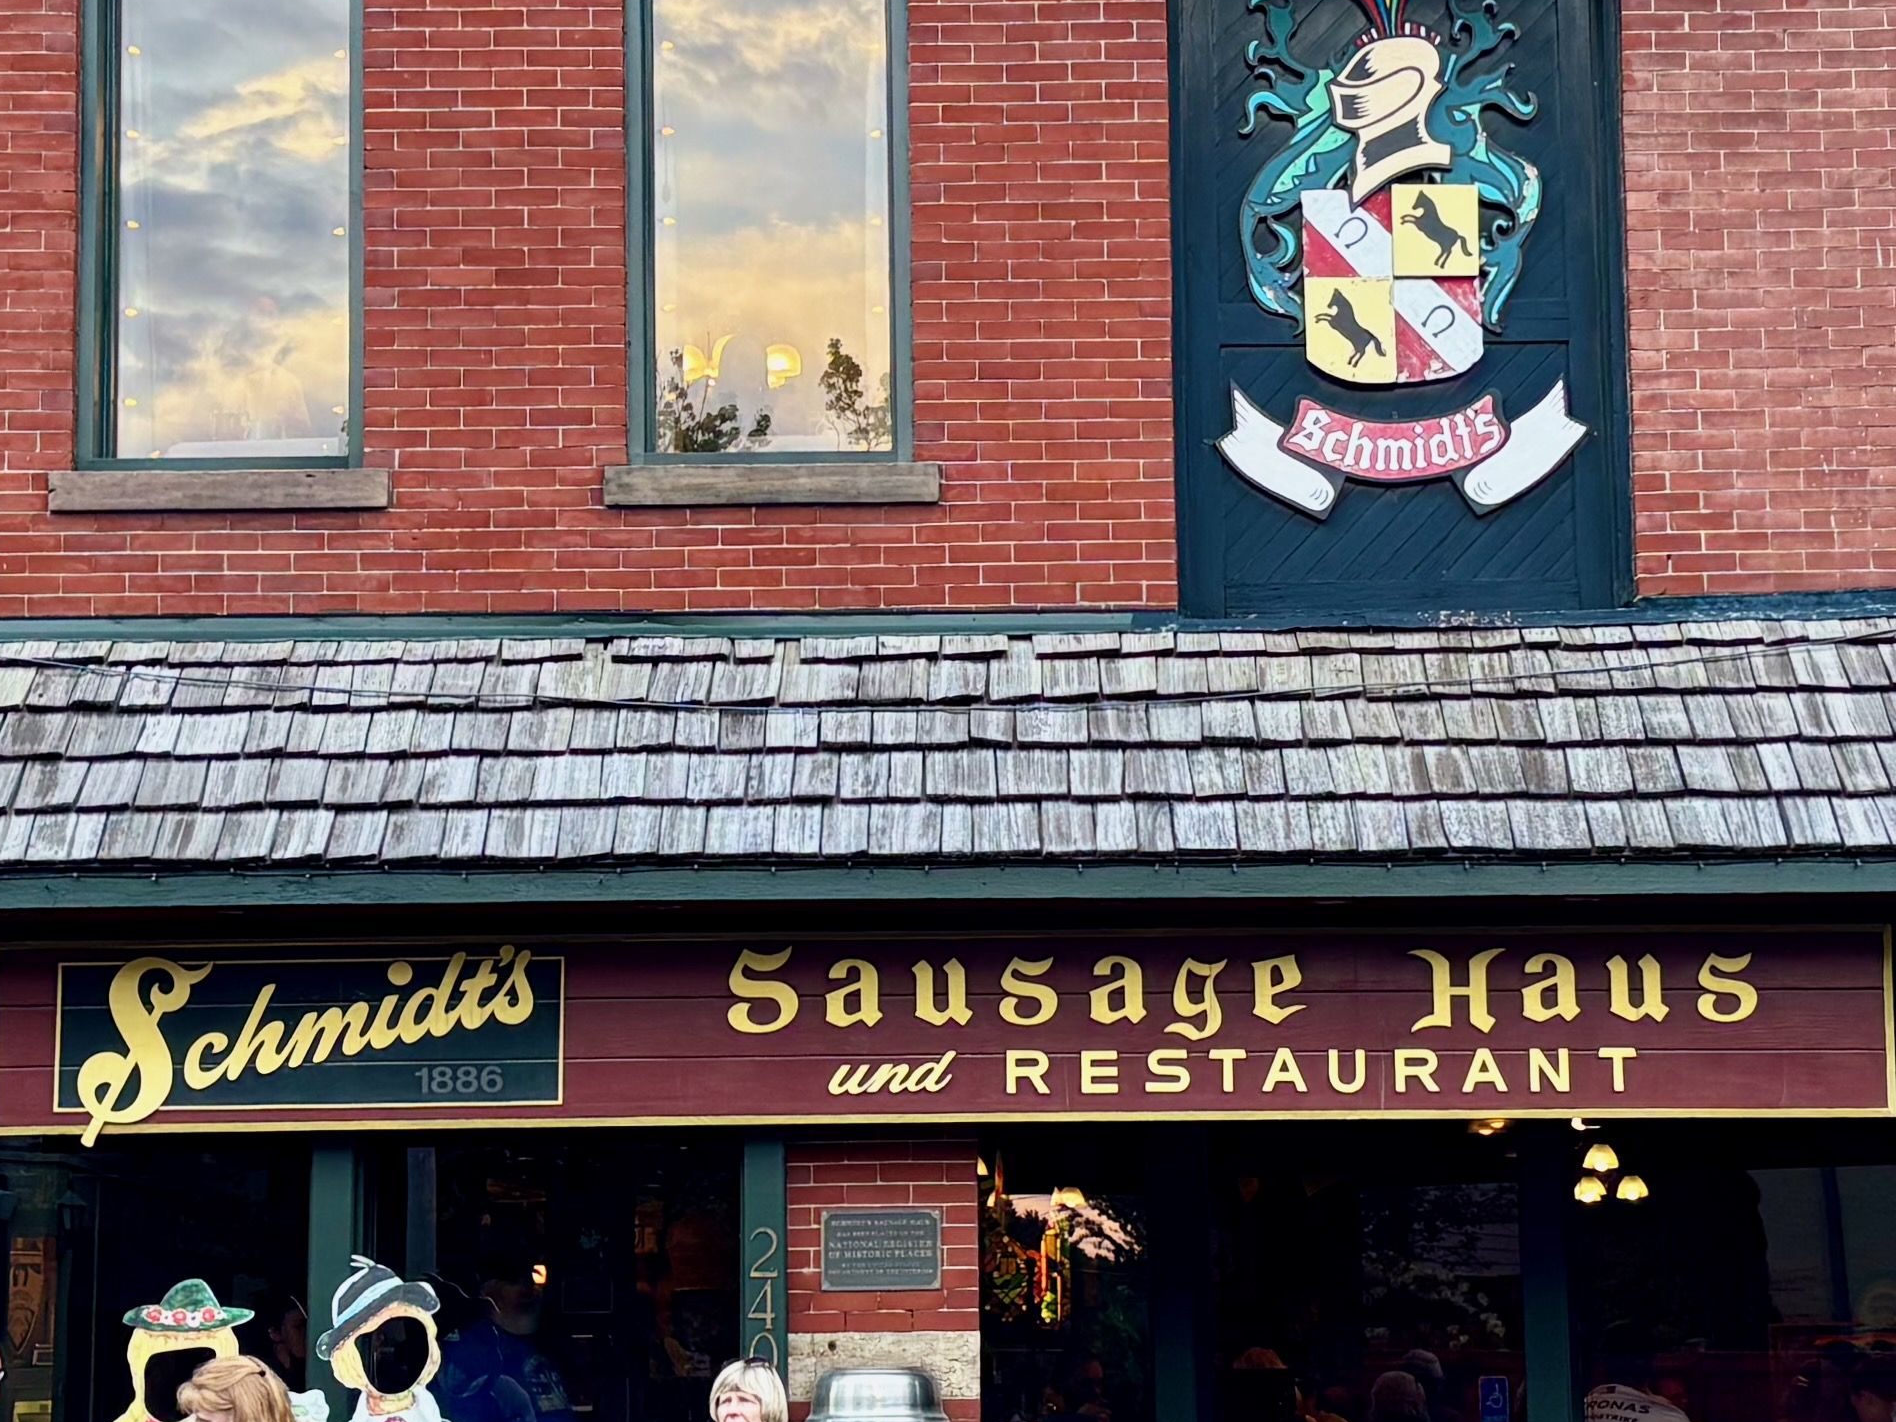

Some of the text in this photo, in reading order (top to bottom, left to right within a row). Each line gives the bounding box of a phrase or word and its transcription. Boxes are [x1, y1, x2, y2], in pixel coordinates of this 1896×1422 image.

[1288, 408, 1501, 471] Schmidt's
[726, 945, 1758, 1041] Sausage Haus
[76, 945, 534, 1148] Schmidt's
[827, 1047, 1637, 1095] und RESTAURANT
[414, 1065, 504, 1094] 1886
